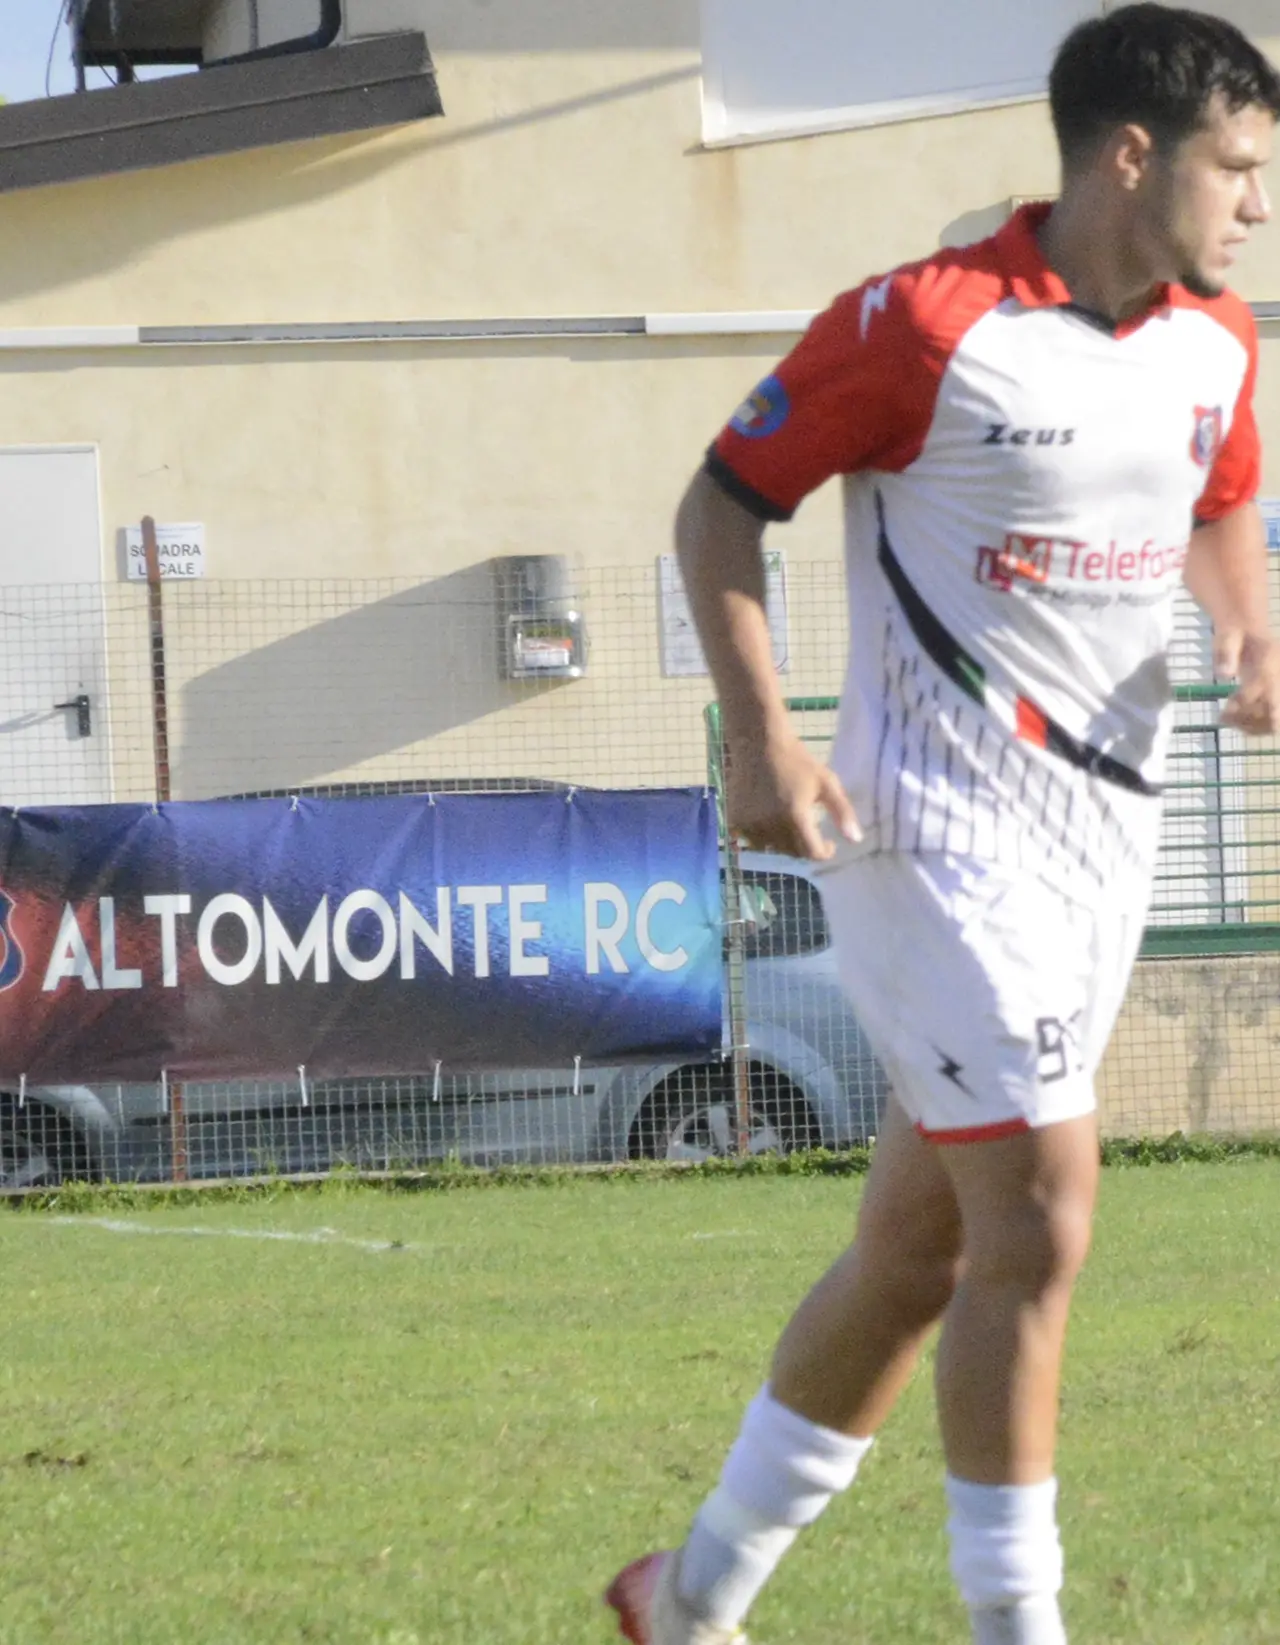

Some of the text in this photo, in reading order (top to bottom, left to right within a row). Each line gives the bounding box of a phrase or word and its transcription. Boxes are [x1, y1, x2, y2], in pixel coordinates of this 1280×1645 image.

[983, 423, 1075, 446] Zeus
[129, 543, 202, 558] SADRA
[138, 561, 195, 576] LCALE
[41, 880, 688, 992] ALTOMONTE RC
